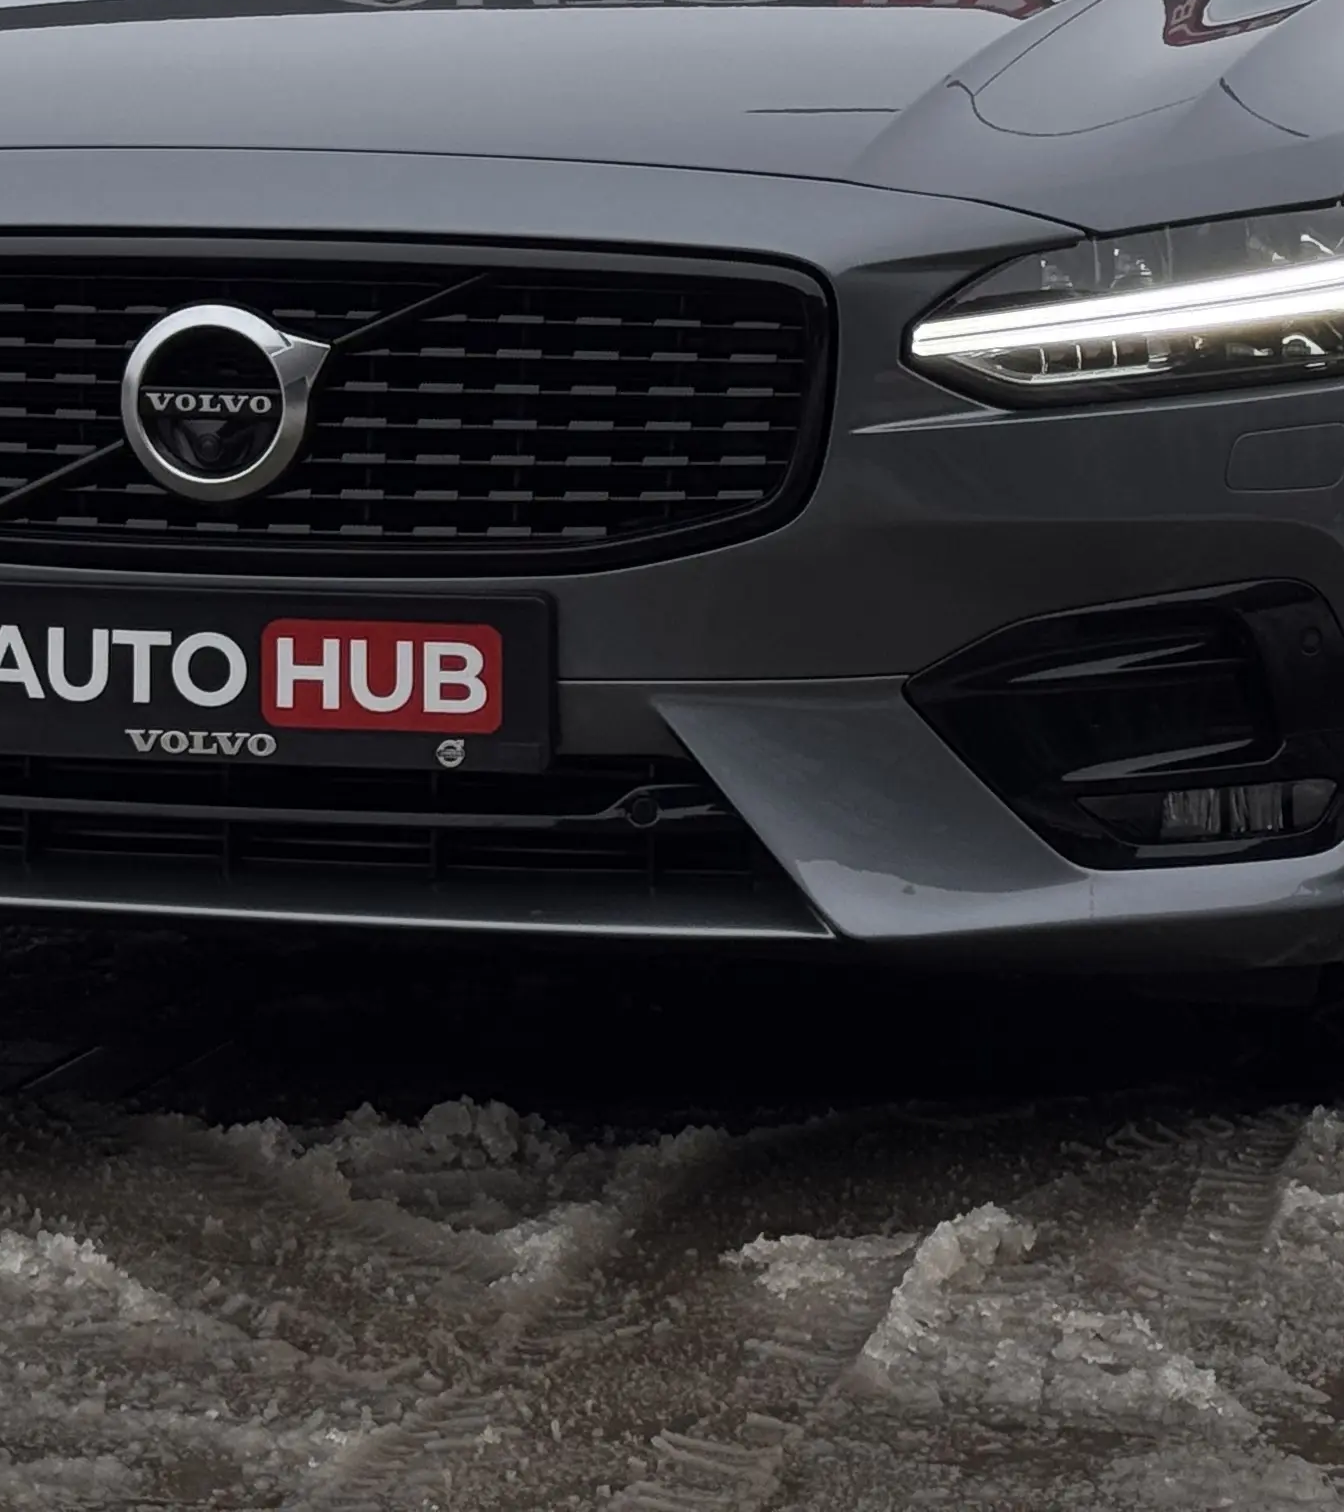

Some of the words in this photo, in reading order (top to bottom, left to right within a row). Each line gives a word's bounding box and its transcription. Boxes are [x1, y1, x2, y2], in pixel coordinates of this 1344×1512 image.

[146, 392, 272, 414] VOLVO
[276, 637, 488, 714] HUB
[125, 729, 277, 757] VOLVO
